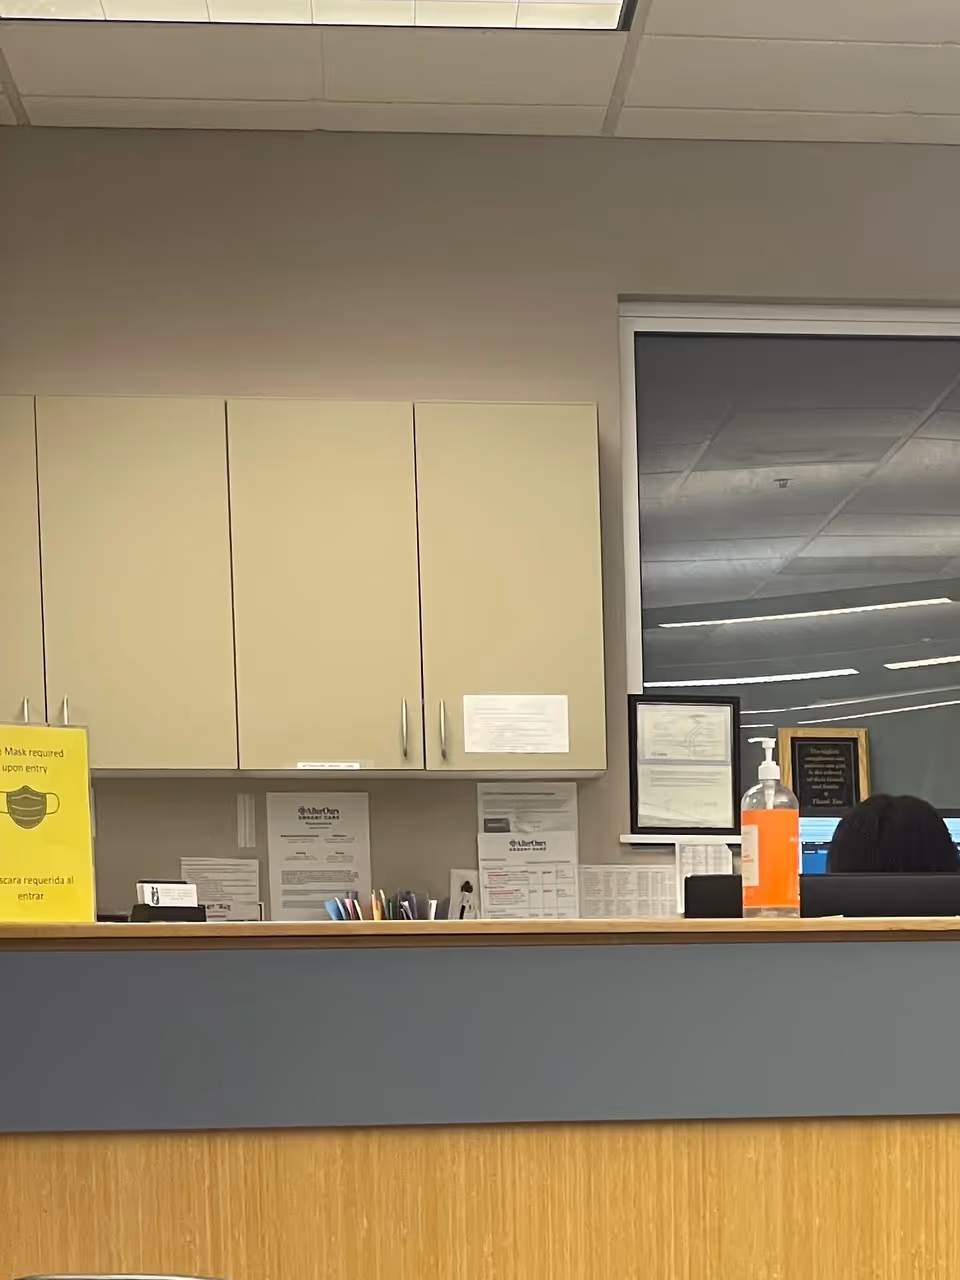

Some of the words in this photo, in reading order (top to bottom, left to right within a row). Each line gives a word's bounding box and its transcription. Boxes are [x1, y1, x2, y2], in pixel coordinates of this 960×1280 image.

[4, 746, 27, 756] Mask
[29, 749, 64, 758] required
[2, 764, 23, 773] upon
[26, 765, 48, 774] entry
[23, 876, 65, 886] requerida
[66, 876, 74, 884] al
[17, 892, 44, 900] entrar
